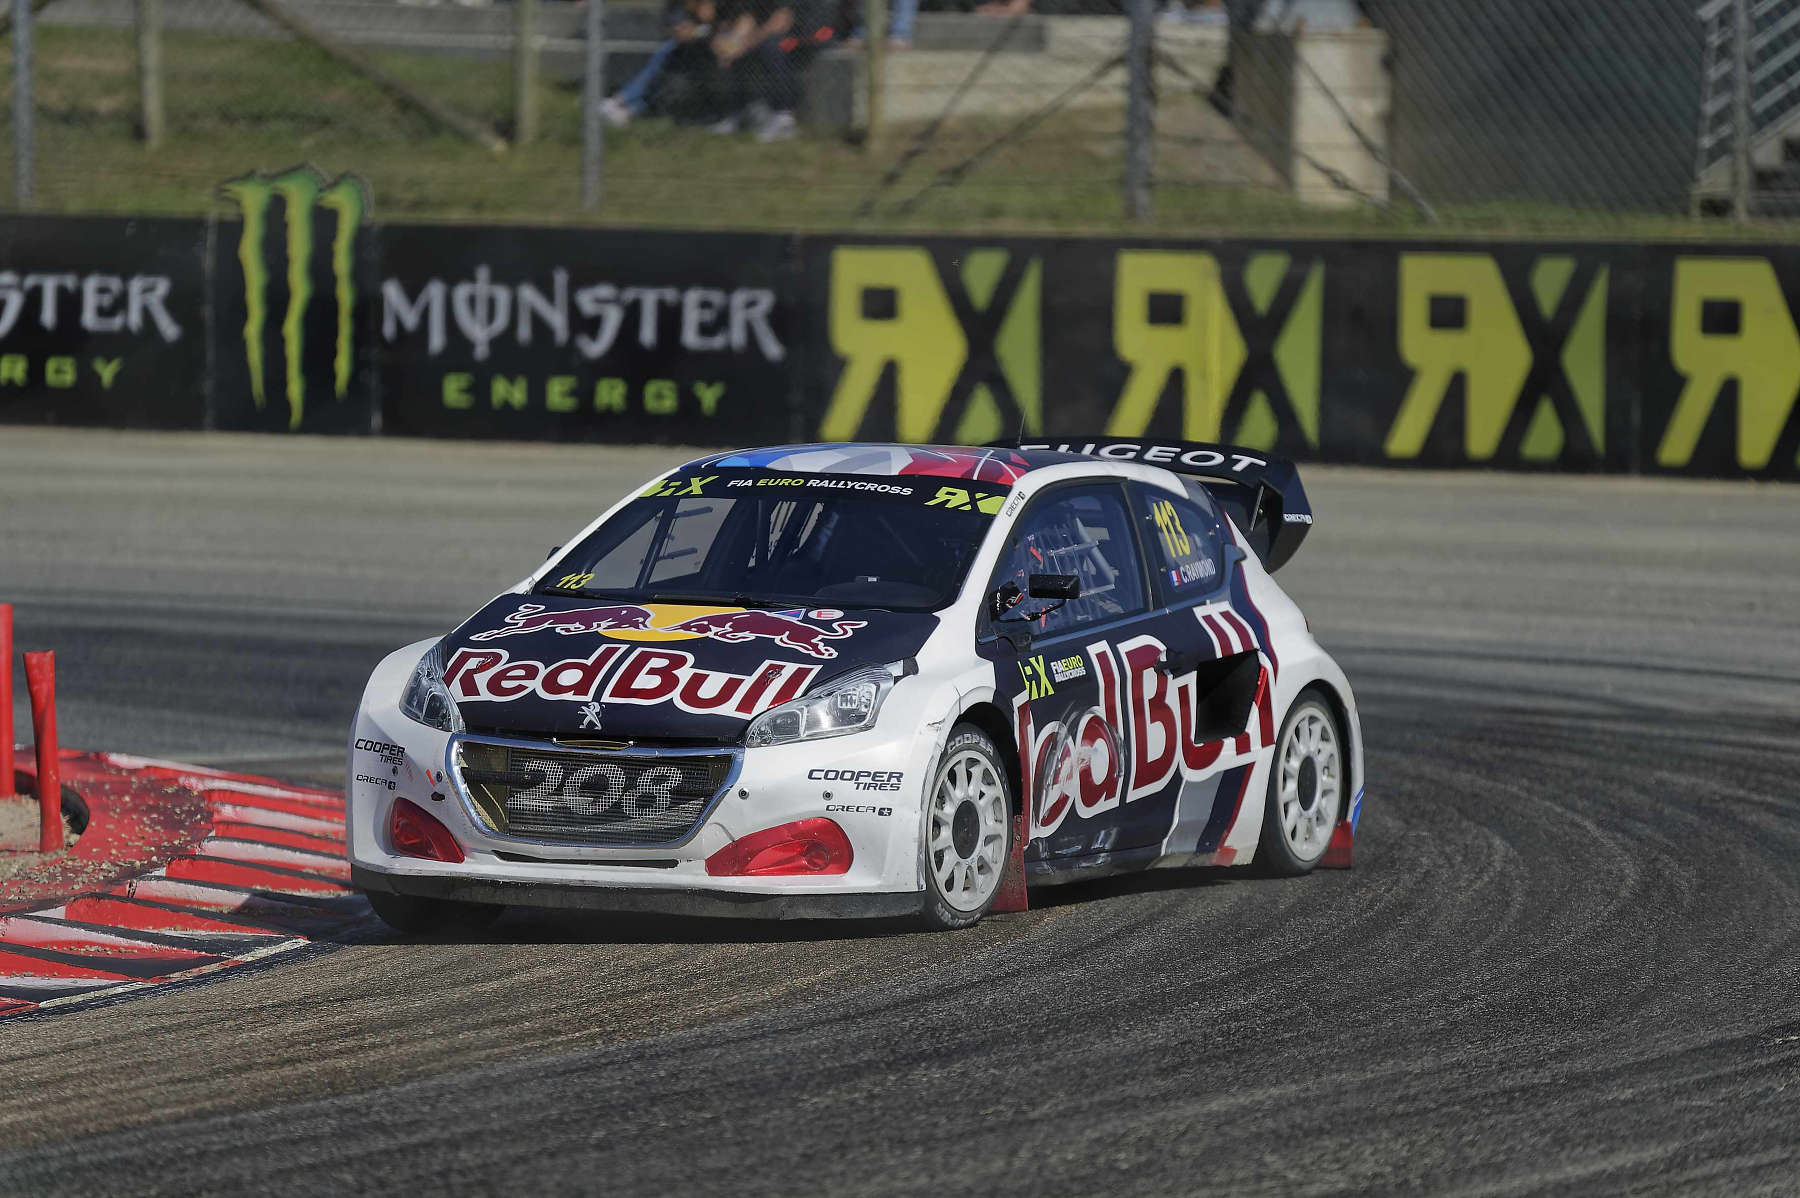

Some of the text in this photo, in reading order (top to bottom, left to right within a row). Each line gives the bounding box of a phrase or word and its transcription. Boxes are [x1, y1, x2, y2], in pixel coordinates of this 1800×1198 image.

[381, 262, 787, 362] MONSTER
[442, 371, 726, 416] ENERGY
[727, 478, 914, 496] FIA EURO RALLYCROSS
[1152, 500, 1191, 559] 113
[556, 573, 595, 589] 113
[443, 644, 821, 719] Red Bull
[355, 738, 405, 757] COOPER
[380, 754, 403, 766] TIRES
[807, 768, 904, 783] COOPER
[505, 759, 683, 819] 208
[854, 781, 901, 791] TIRES
[825, 804, 877, 813] ORECA
